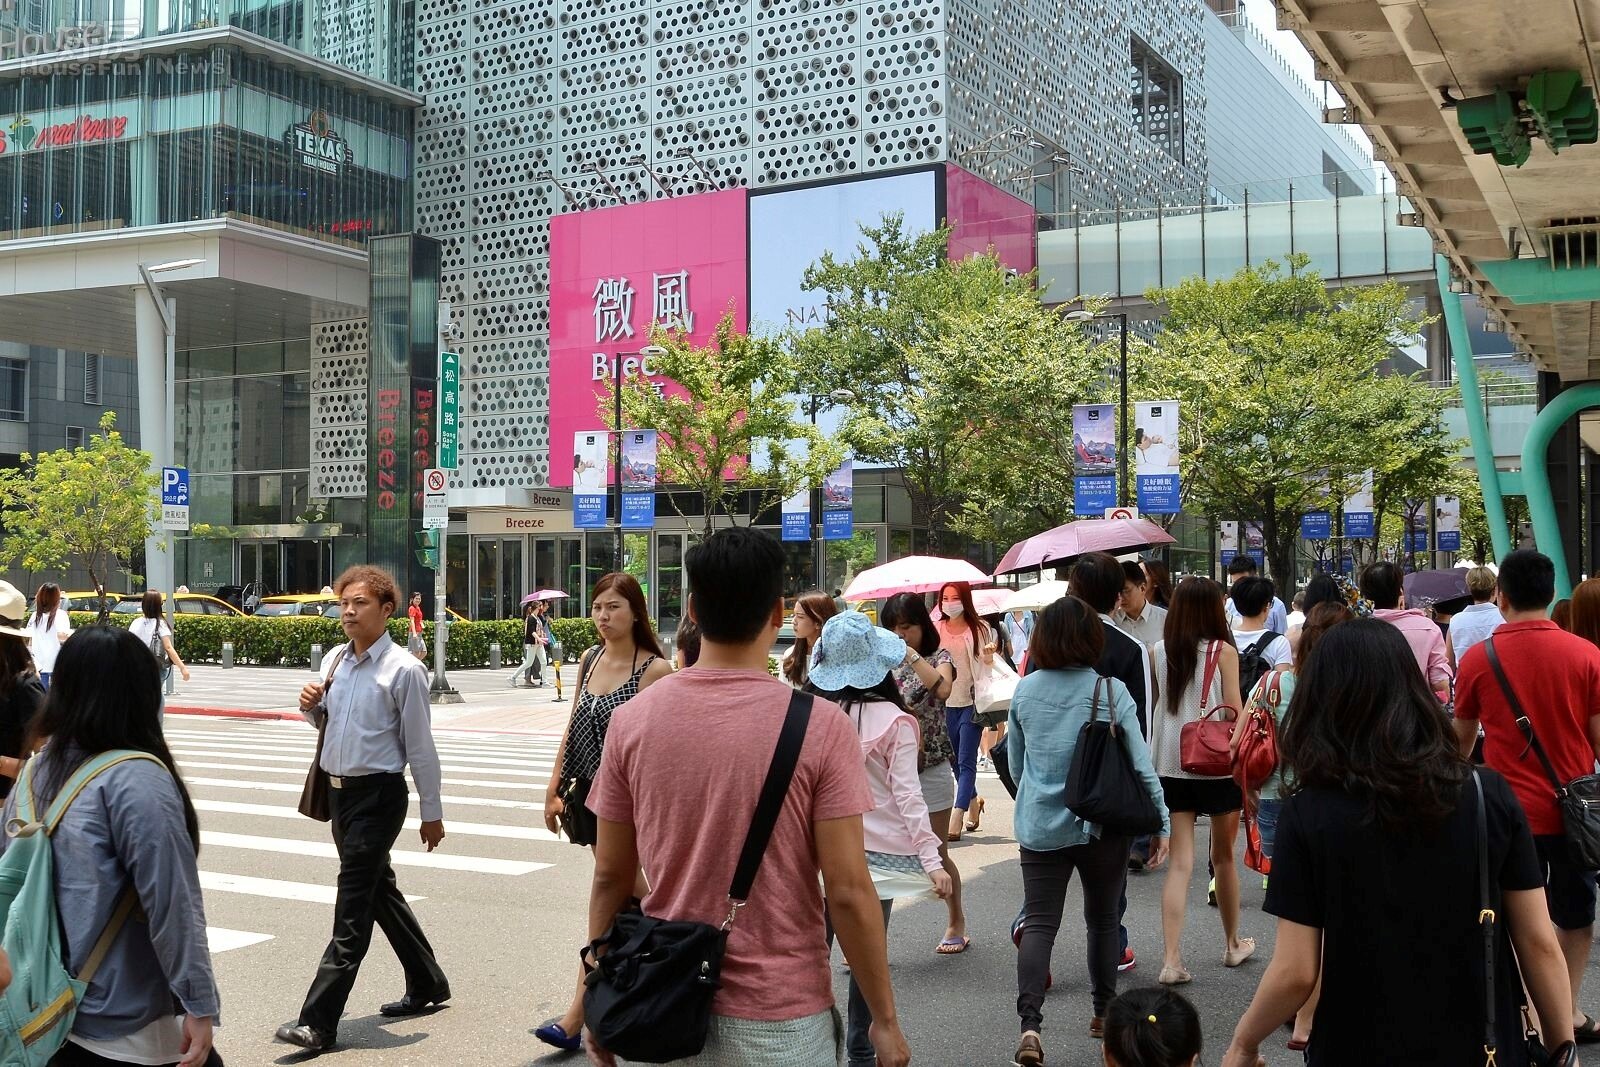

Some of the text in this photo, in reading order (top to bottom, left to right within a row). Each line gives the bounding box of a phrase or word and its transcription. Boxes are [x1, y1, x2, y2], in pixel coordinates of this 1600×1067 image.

[295, 130, 346, 162] TEXAS
[592, 268, 694, 343] 微風
[444, 368, 455, 426] 松高路
[377, 389, 401, 510] Breeze
[163, 469, 180, 493] P
[533, 493, 561, 506] Breeze
[506, 517, 544, 528] Breeze
